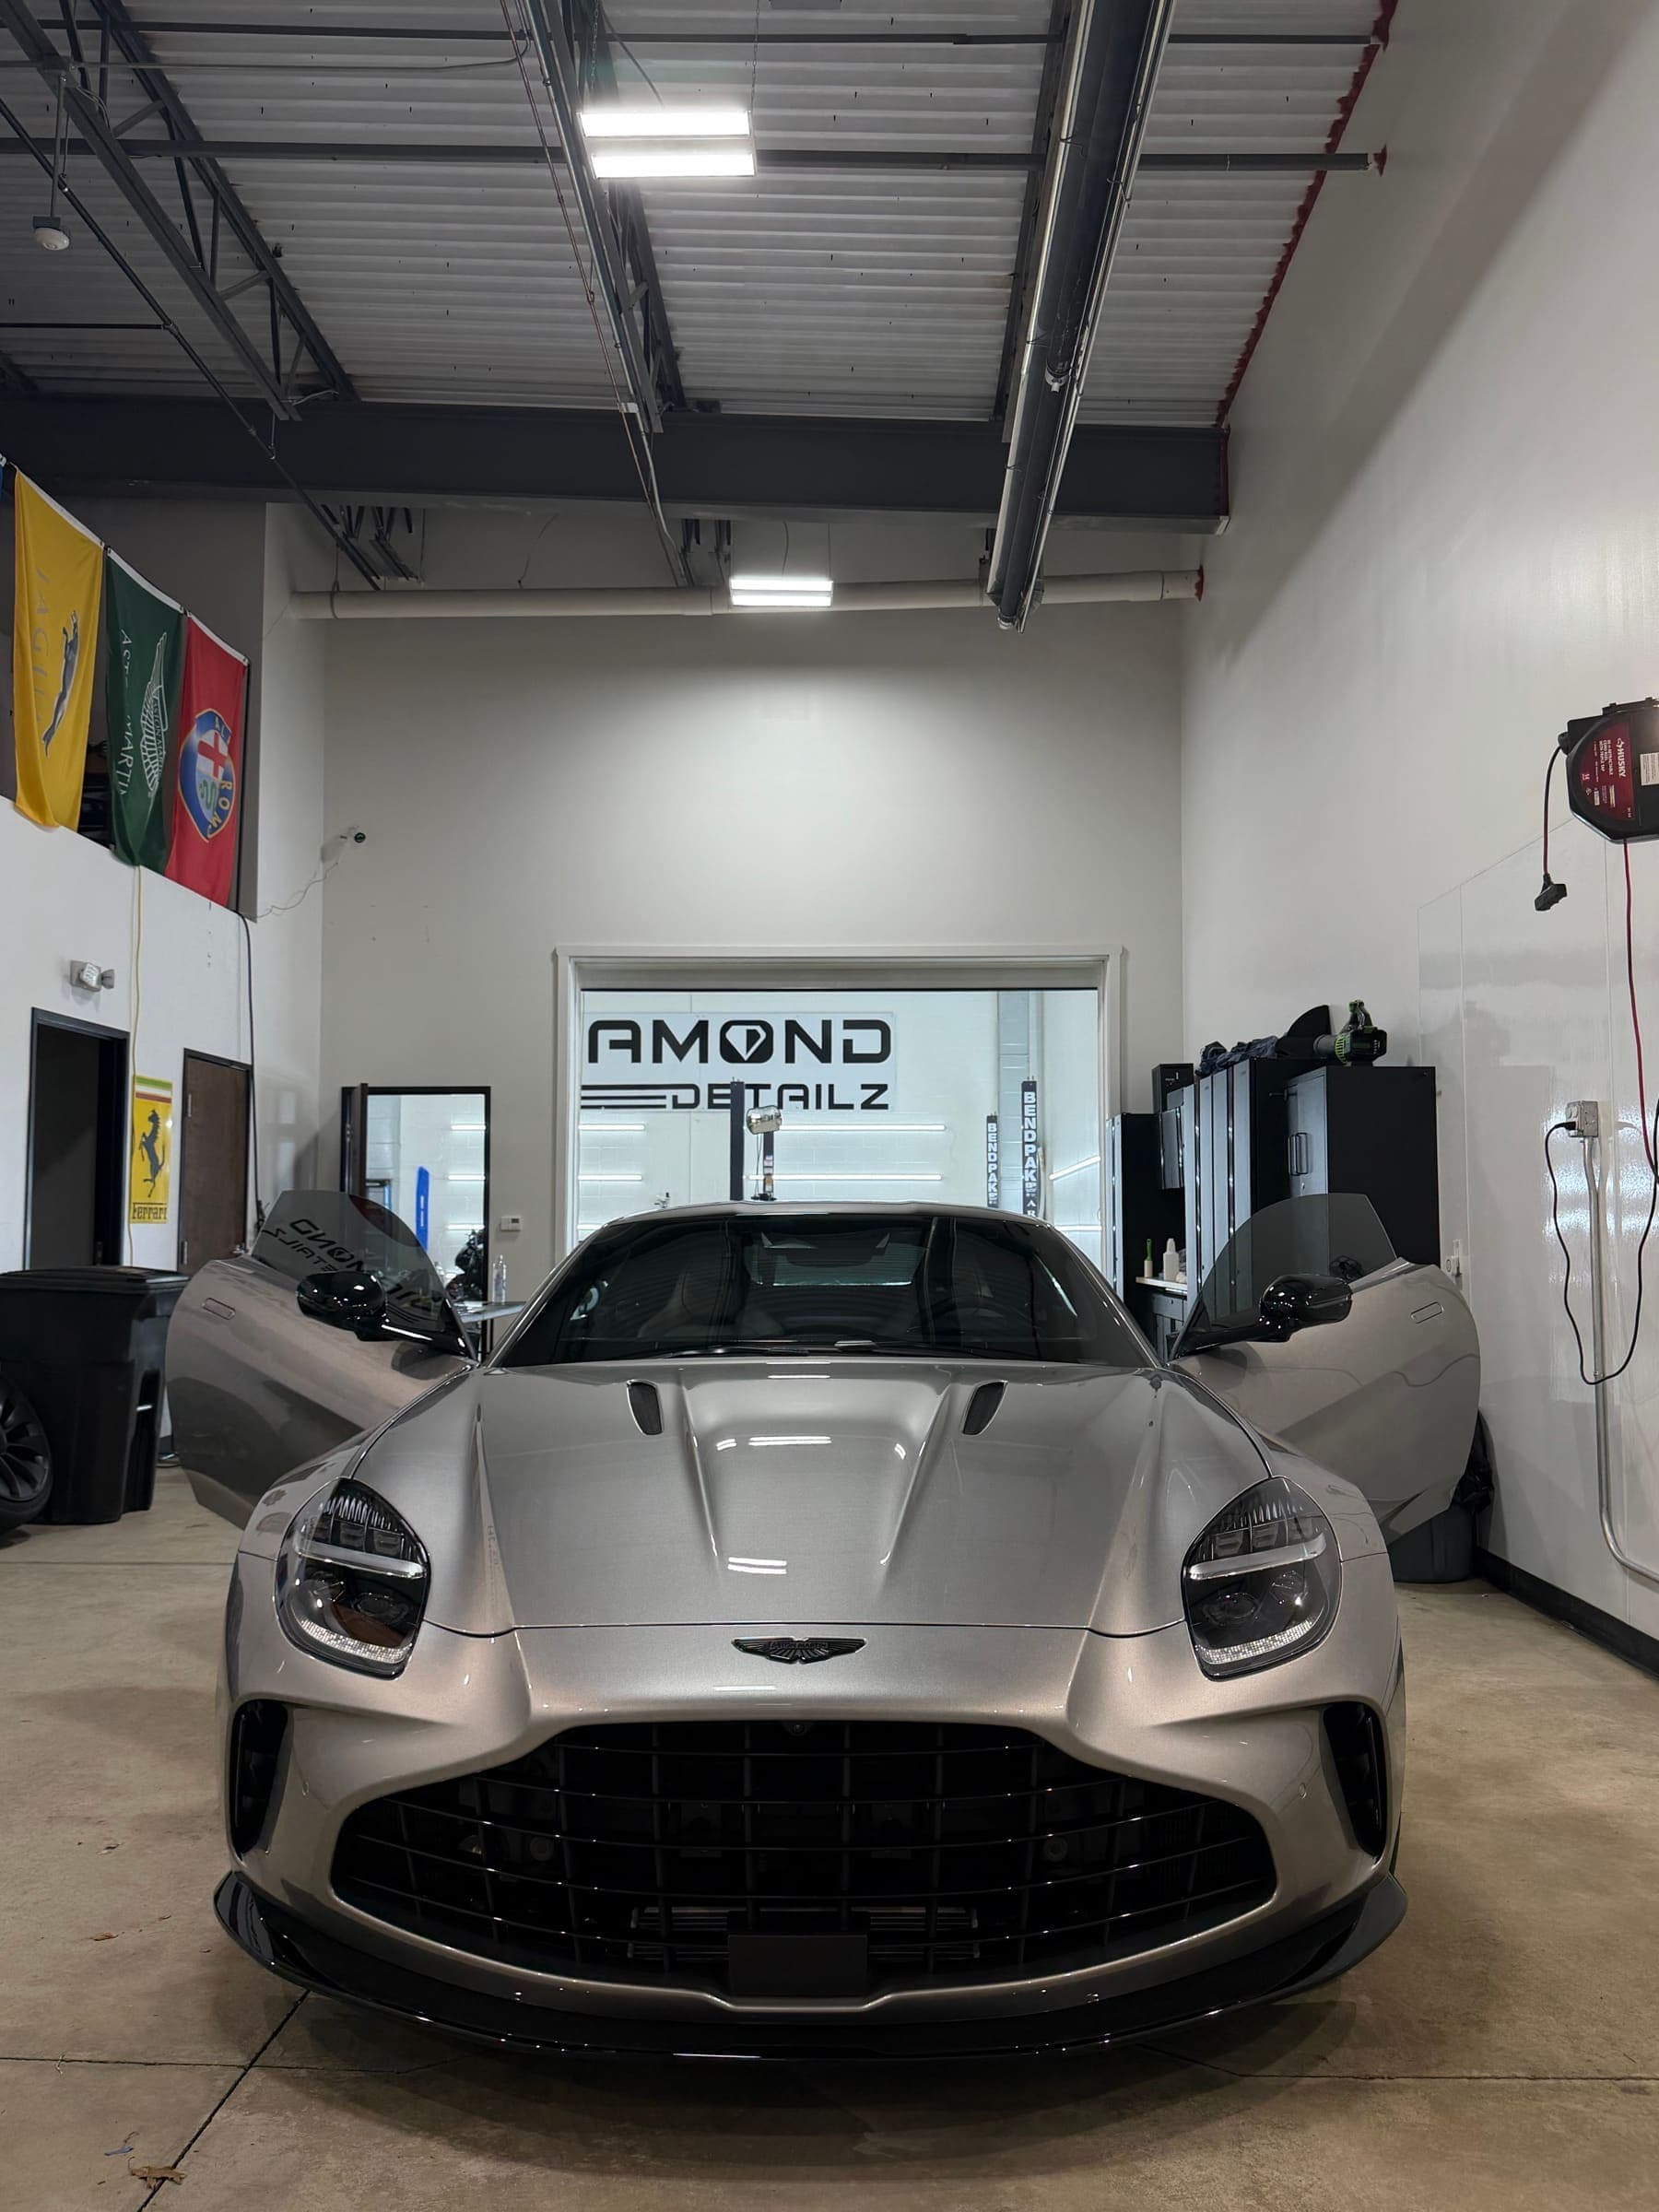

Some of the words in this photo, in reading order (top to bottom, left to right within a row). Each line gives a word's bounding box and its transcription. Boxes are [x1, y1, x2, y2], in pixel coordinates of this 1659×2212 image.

[1618, 748, 1627, 778] HUSKY
[672, 1083, 889, 1110] DETAILZ
[987, 1123, 997, 1193] BENDPAK
[1024, 1091, 1037, 1182] BENDPAK
